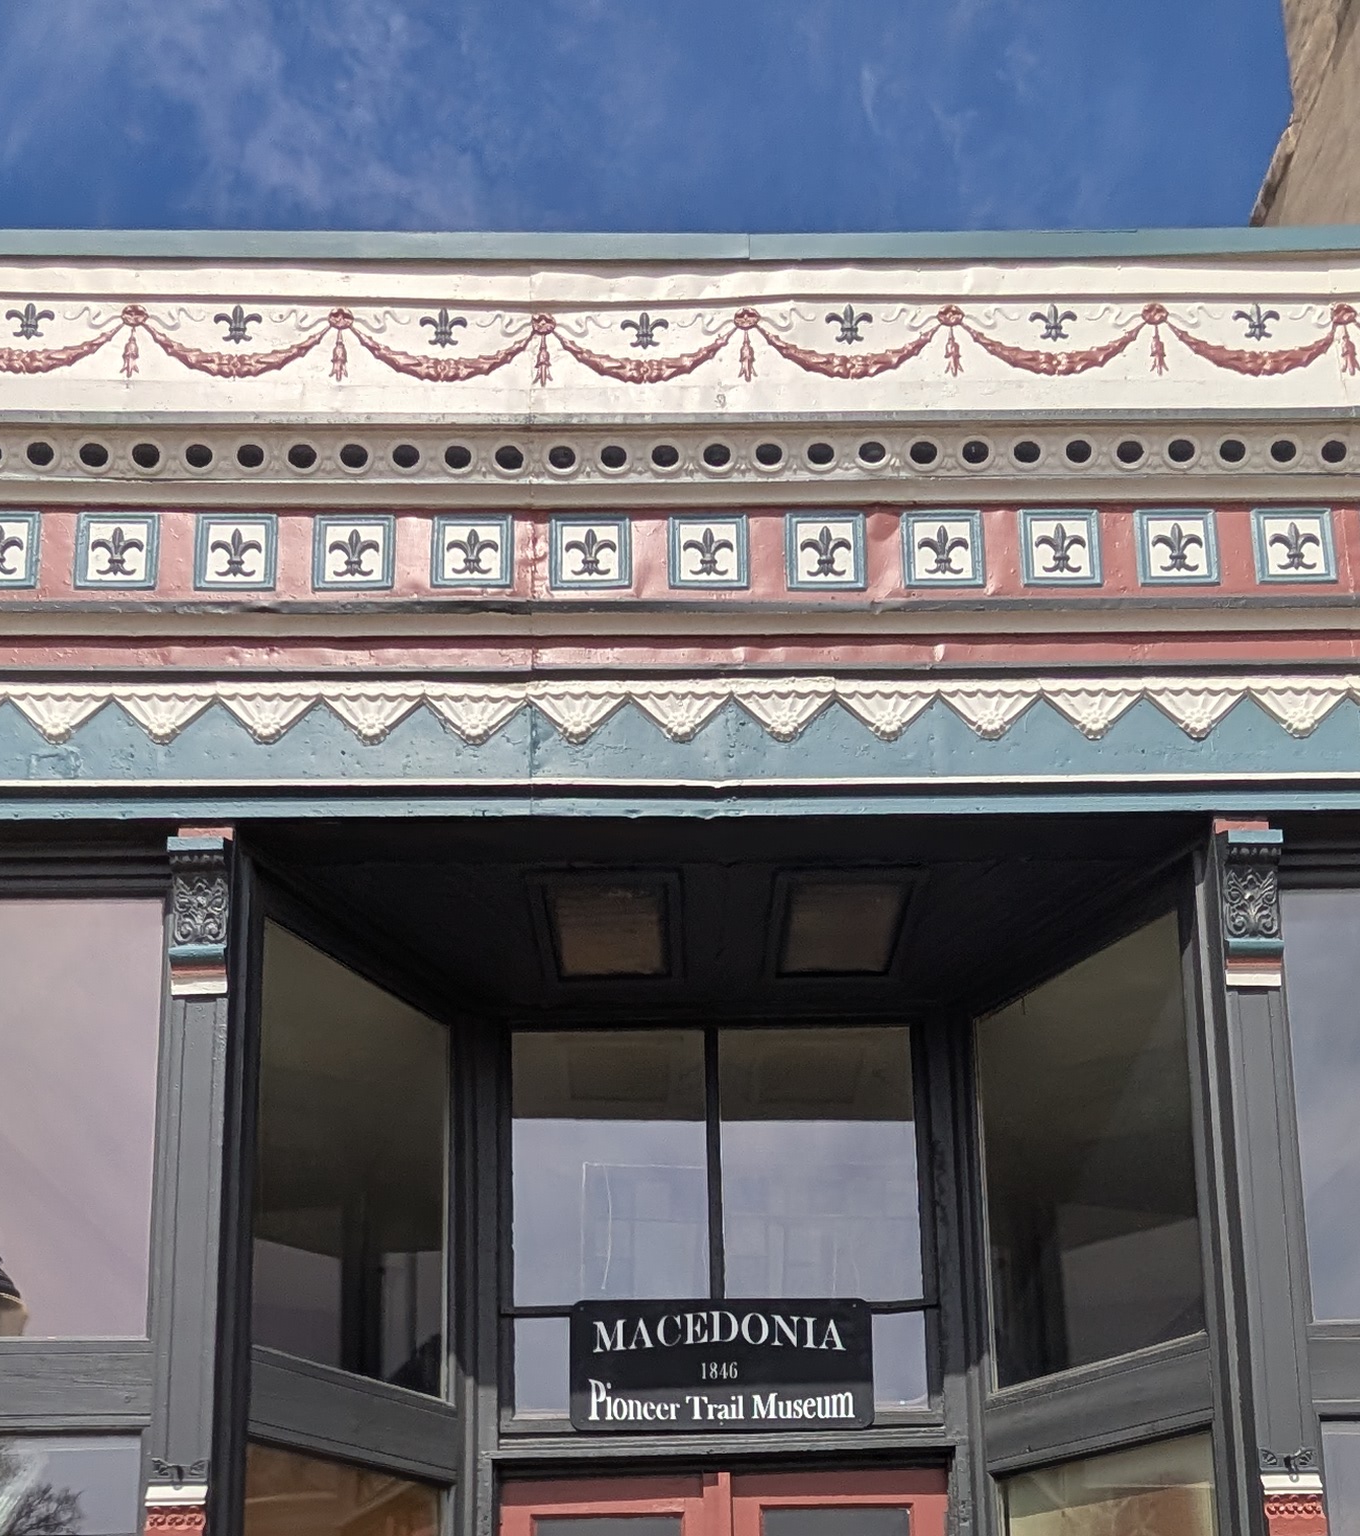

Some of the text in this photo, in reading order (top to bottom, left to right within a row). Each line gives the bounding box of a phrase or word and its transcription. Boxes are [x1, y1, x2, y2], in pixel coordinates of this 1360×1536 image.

[593, 1310, 847, 1353] MACEDONIA
[700, 1361, 739, 1380] 1846
[588, 1378, 856, 1421] Pioneer Trail Museum
